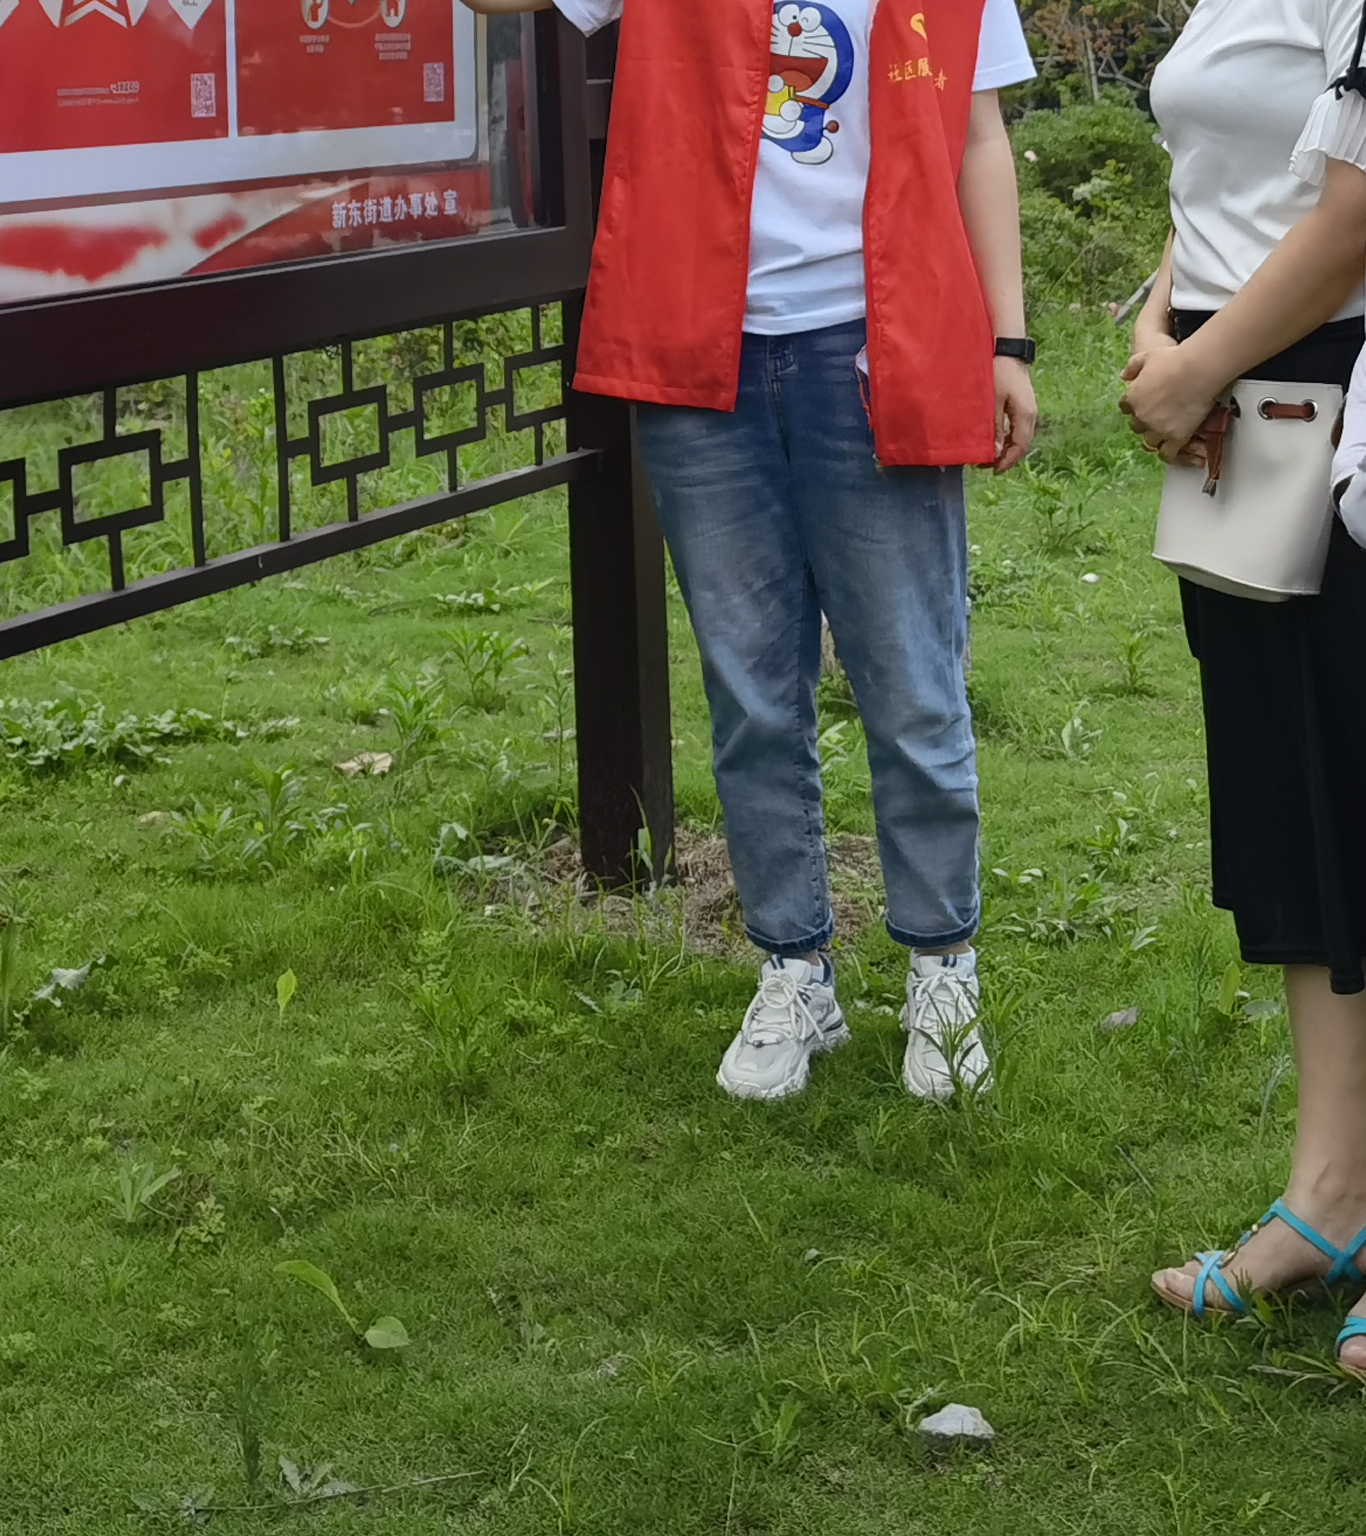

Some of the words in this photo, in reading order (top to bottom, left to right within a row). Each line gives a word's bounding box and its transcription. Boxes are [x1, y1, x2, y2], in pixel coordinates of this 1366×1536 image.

[332, 191, 438, 228] 新东街道办事处
[443, 189, 457, 215] 宣
